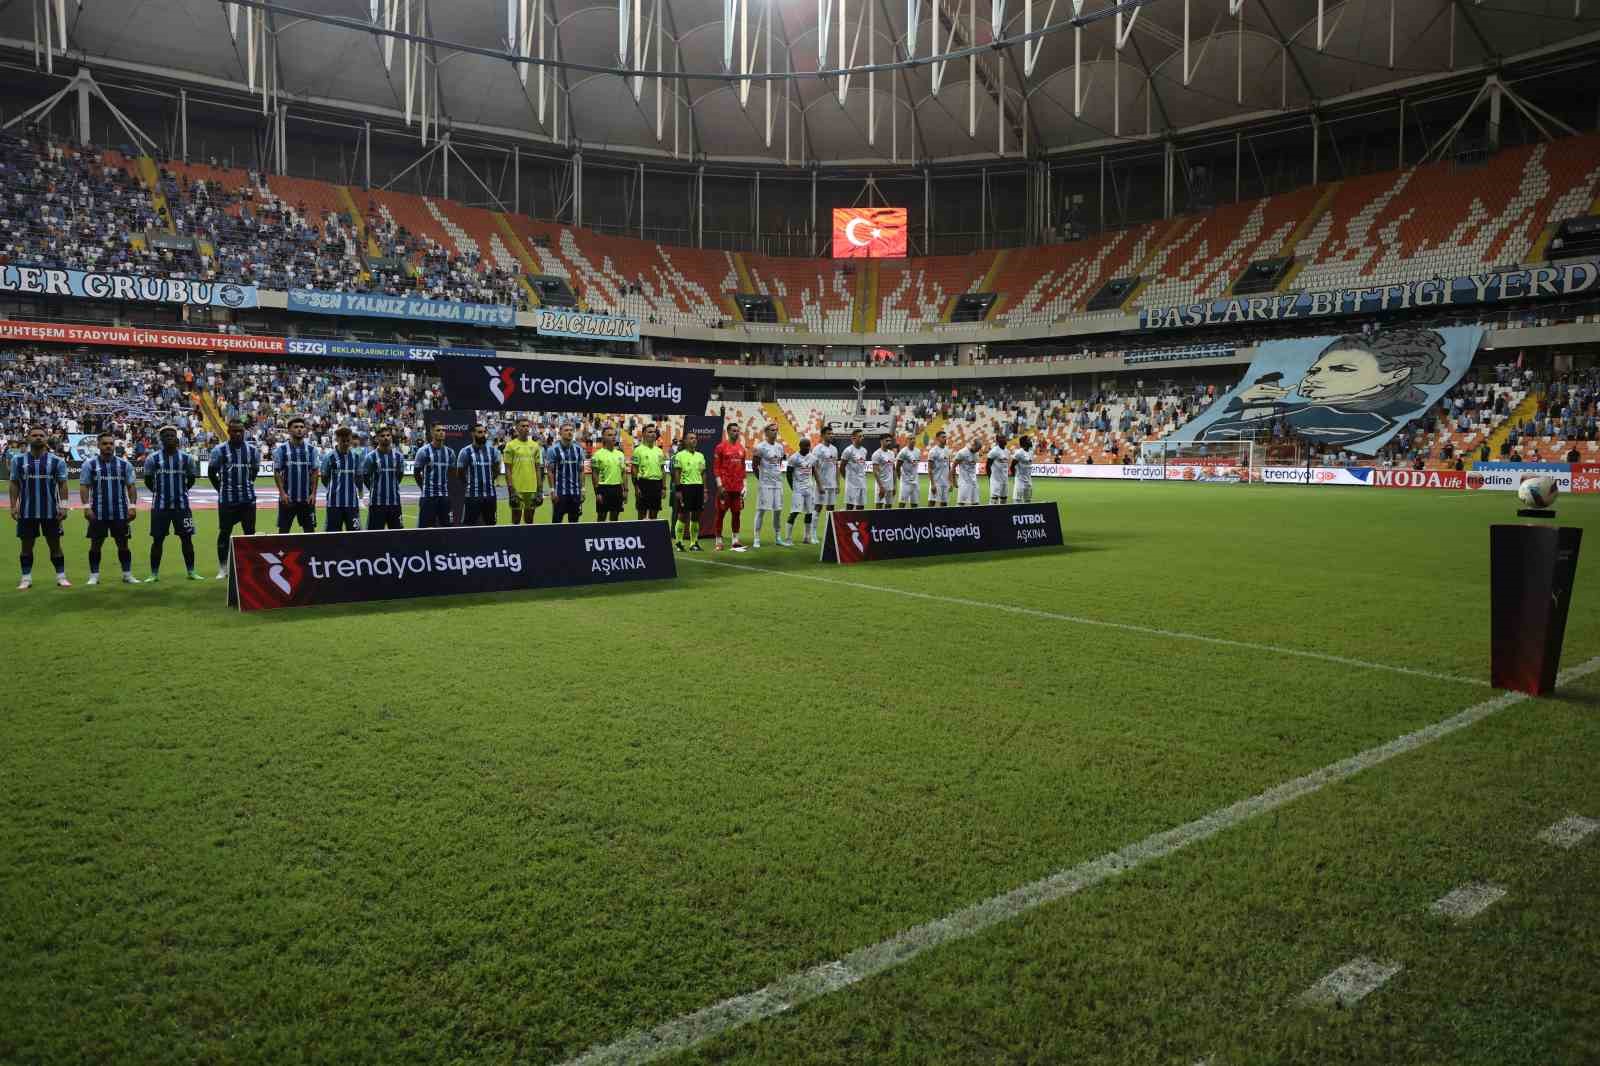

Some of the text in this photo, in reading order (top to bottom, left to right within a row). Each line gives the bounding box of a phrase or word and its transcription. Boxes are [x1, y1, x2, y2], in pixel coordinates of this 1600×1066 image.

[84, 273, 213, 304] GRUBU
[1470, 263, 1598, 302] YERD
[308, 293, 341, 308] SEN
[346, 295, 405, 313] YALNIZ
[408, 301, 460, 319] KALMA
[69, 329, 130, 342] STADYUM
[132, 332, 158, 345] İÇİN
[161, 335, 208, 346] SONSUZ
[211, 338, 283, 350] TEŞEKKÜRLER
[519, 372, 613, 401] trendyol
[1264, 469, 1314, 481] trendyol
[1375, 471, 1441, 488] MODA
[1013, 513, 1046, 525] FUTBOL
[870, 522, 935, 543] trendyol
[1016, 529, 1047, 542] AŞKINA
[584, 535, 646, 552] FUTBOL
[308, 549, 433, 580] trendyol
[591, 557, 647, 576] AŞKINA
